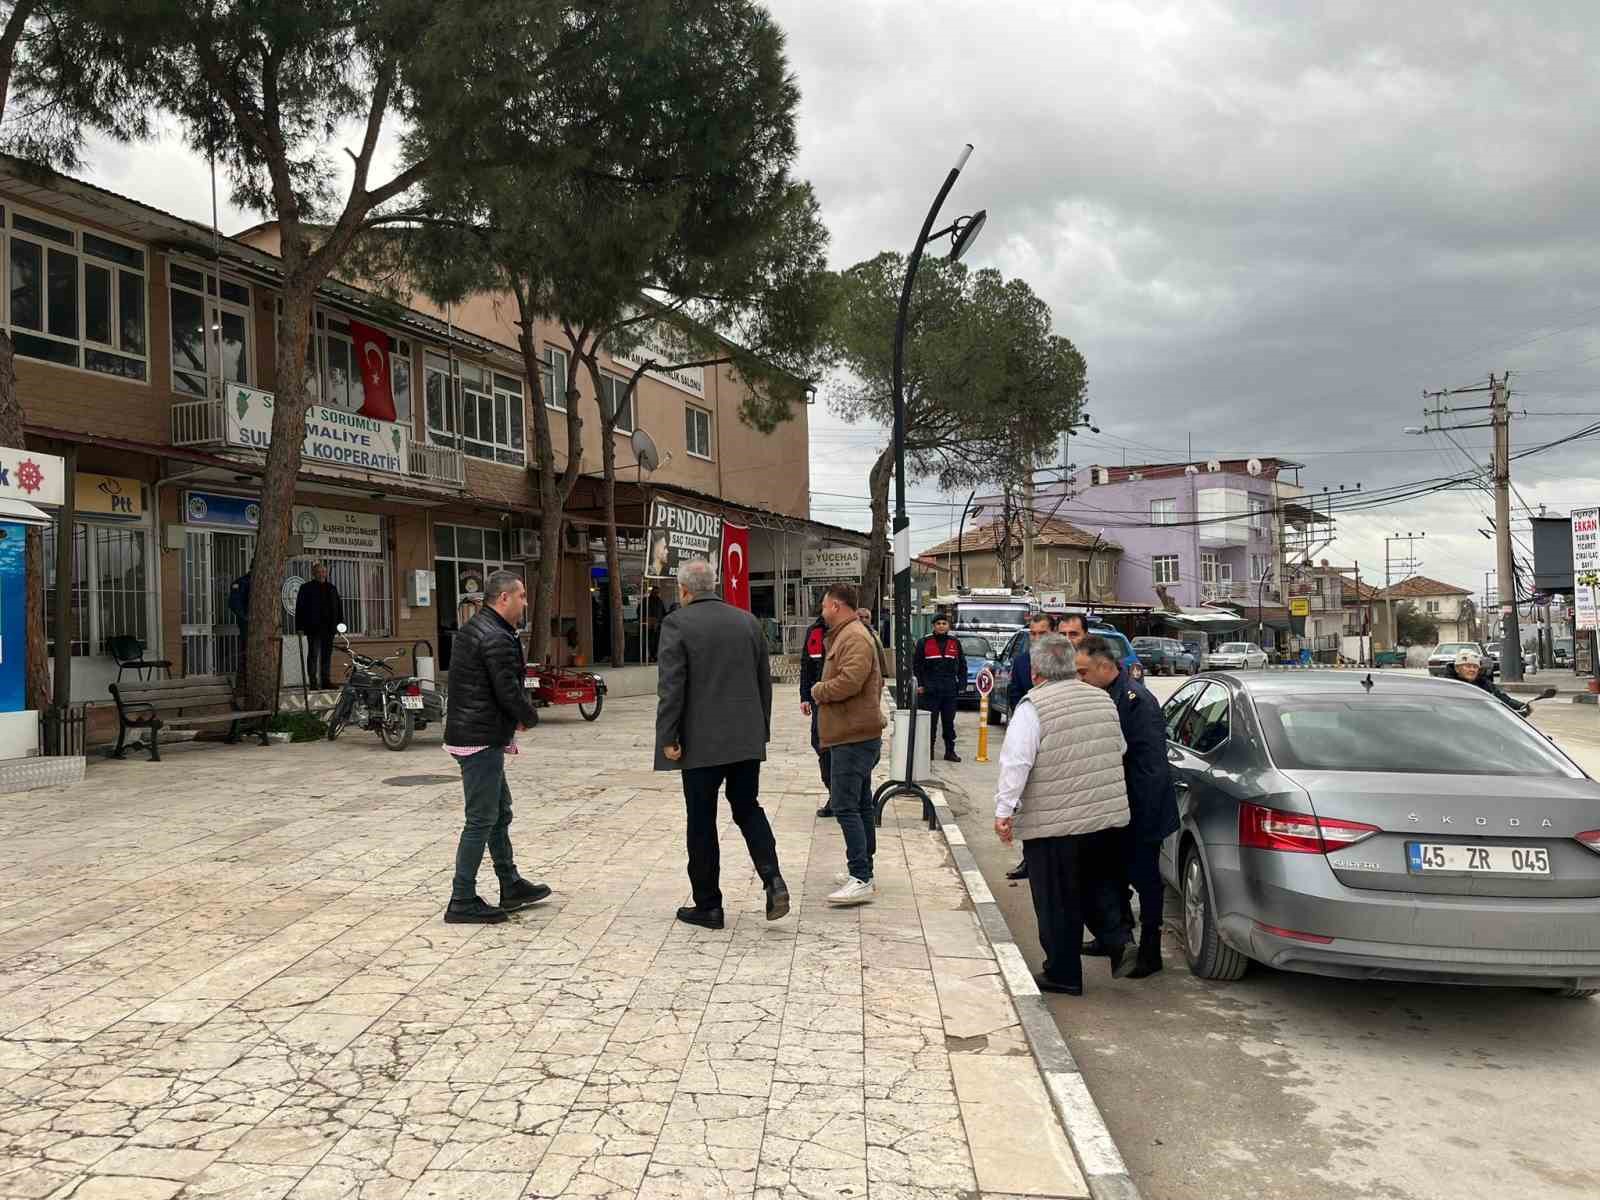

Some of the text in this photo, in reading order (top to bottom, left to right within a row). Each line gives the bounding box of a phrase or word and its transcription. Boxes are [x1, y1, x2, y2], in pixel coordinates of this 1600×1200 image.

[321, 408, 381, 433] SORUMLU
[313, 442, 401, 472] KOOPERATİFİ
[111, 494, 133, 513] Ptt
[655, 504, 721, 538] PENDORE
[1574, 519, 1597, 533] ERKAN
[672, 534, 684, 547] SAÇ
[1422, 845, 1446, 868] 45
[1466, 847, 1492, 870] ZR
[1511, 849, 1548, 872] 045
